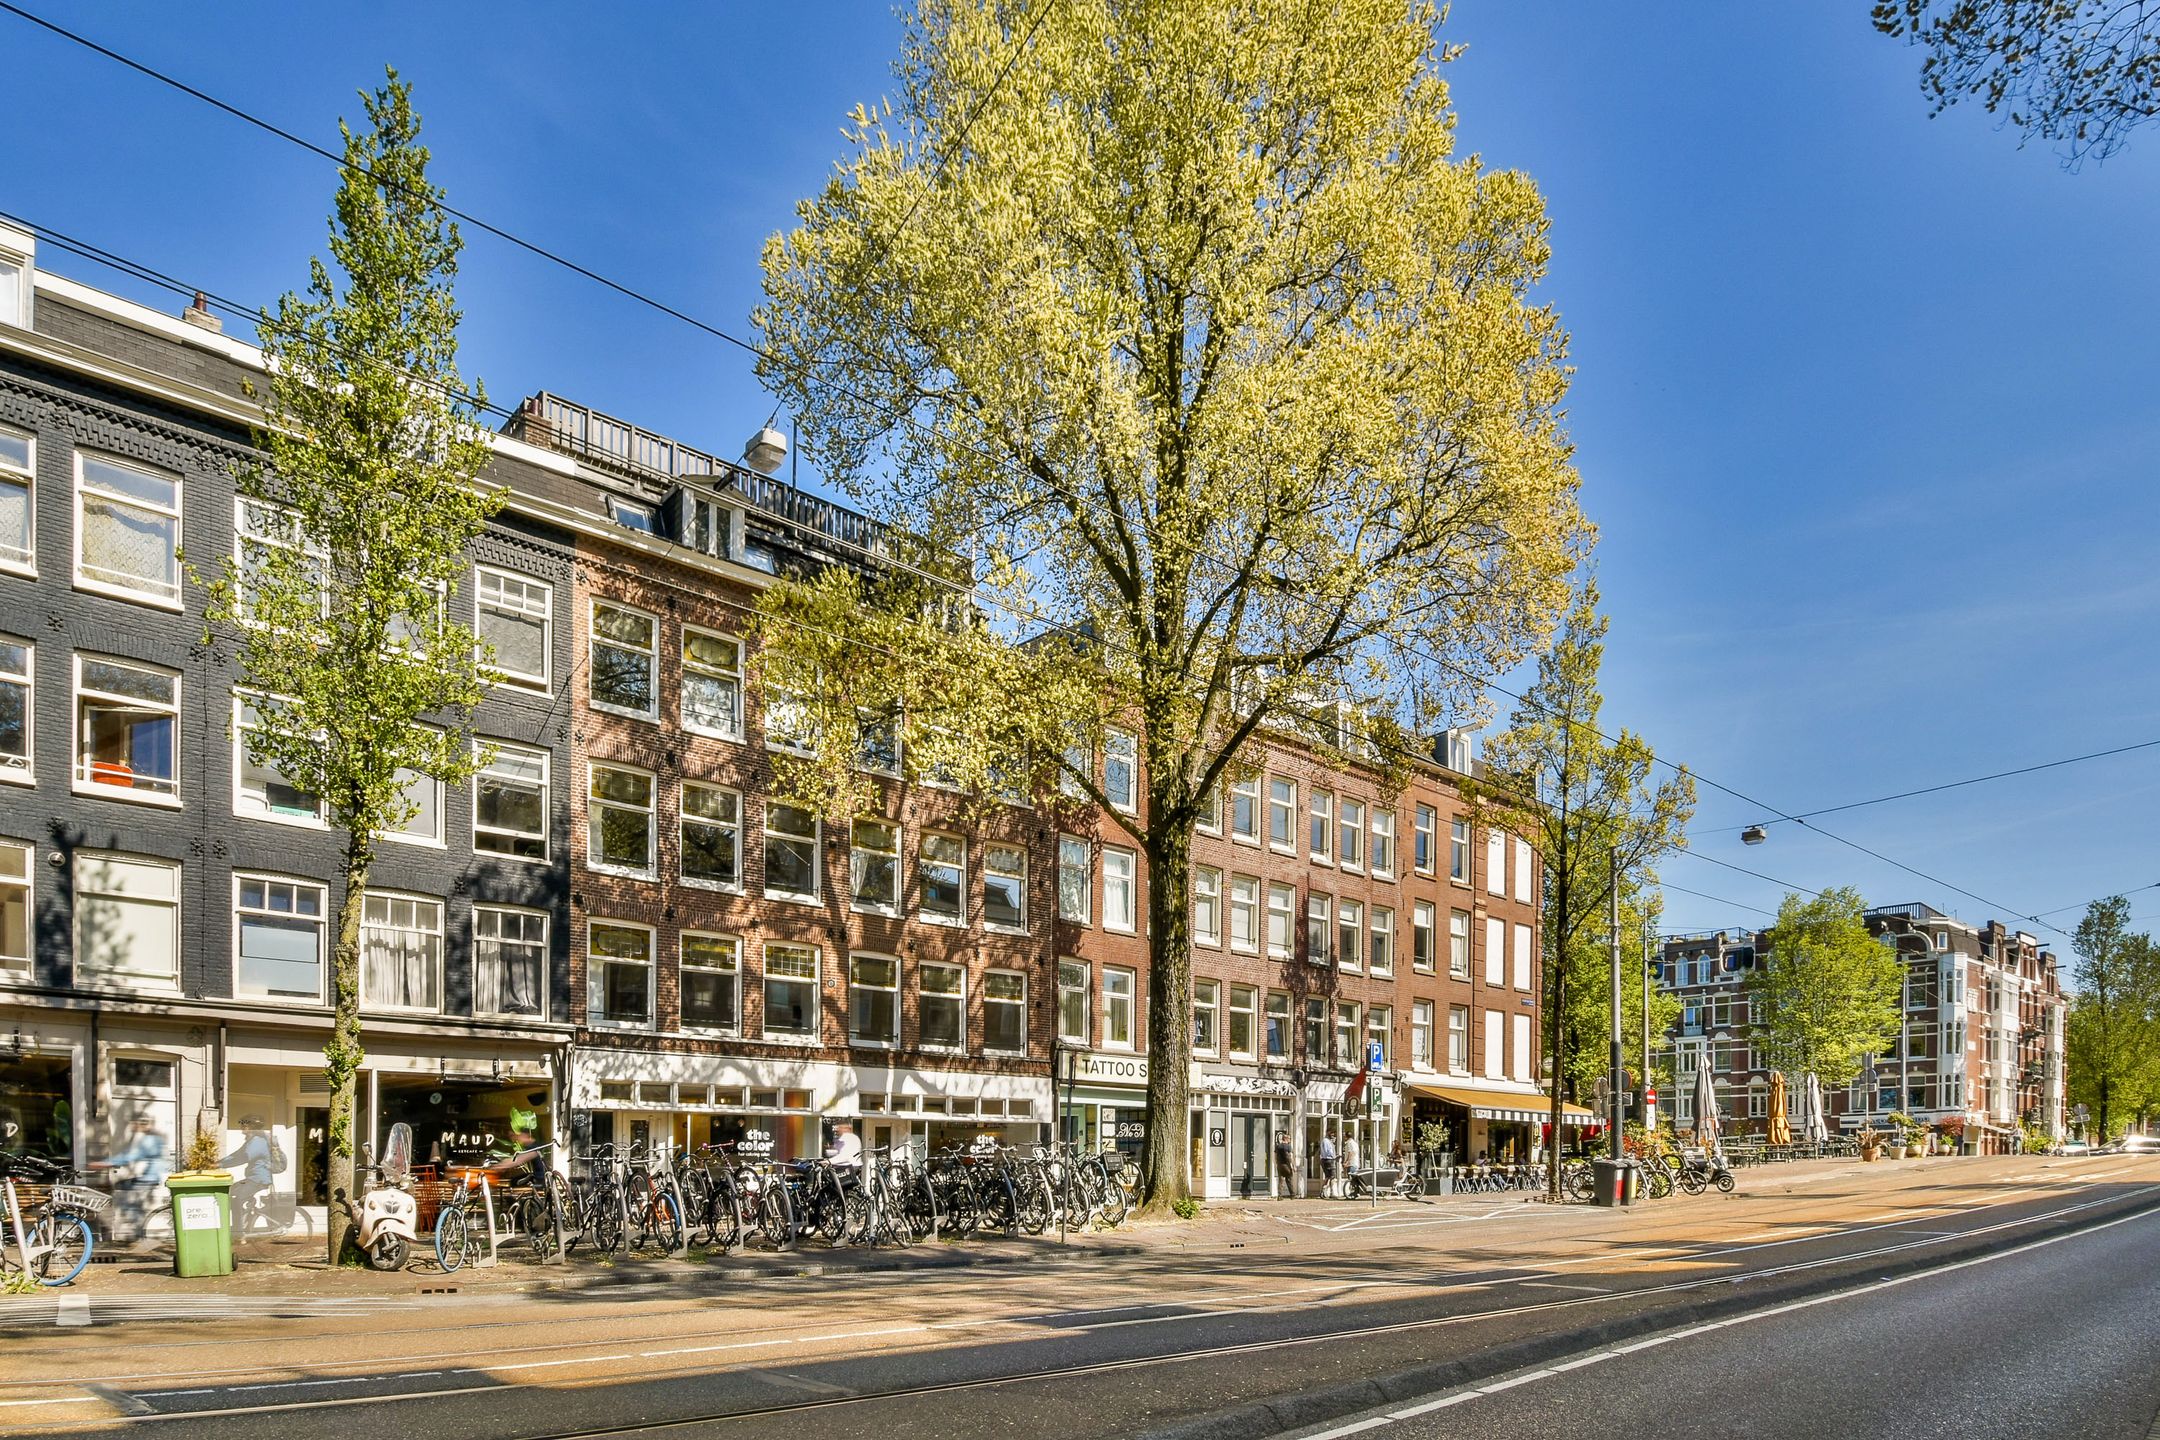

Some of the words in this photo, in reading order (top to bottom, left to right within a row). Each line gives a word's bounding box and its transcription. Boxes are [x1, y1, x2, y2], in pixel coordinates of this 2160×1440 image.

[1373, 1045, 1380, 1060] P
[1082, 1058, 1135, 1077] TATTOO
[1373, 1088, 1380, 1100] P
[308, 1127, 324, 1144] M
[441, 1132, 495, 1147] MAUD
[746, 1129, 770, 1140] the
[976, 1134, 995, 1144] the
